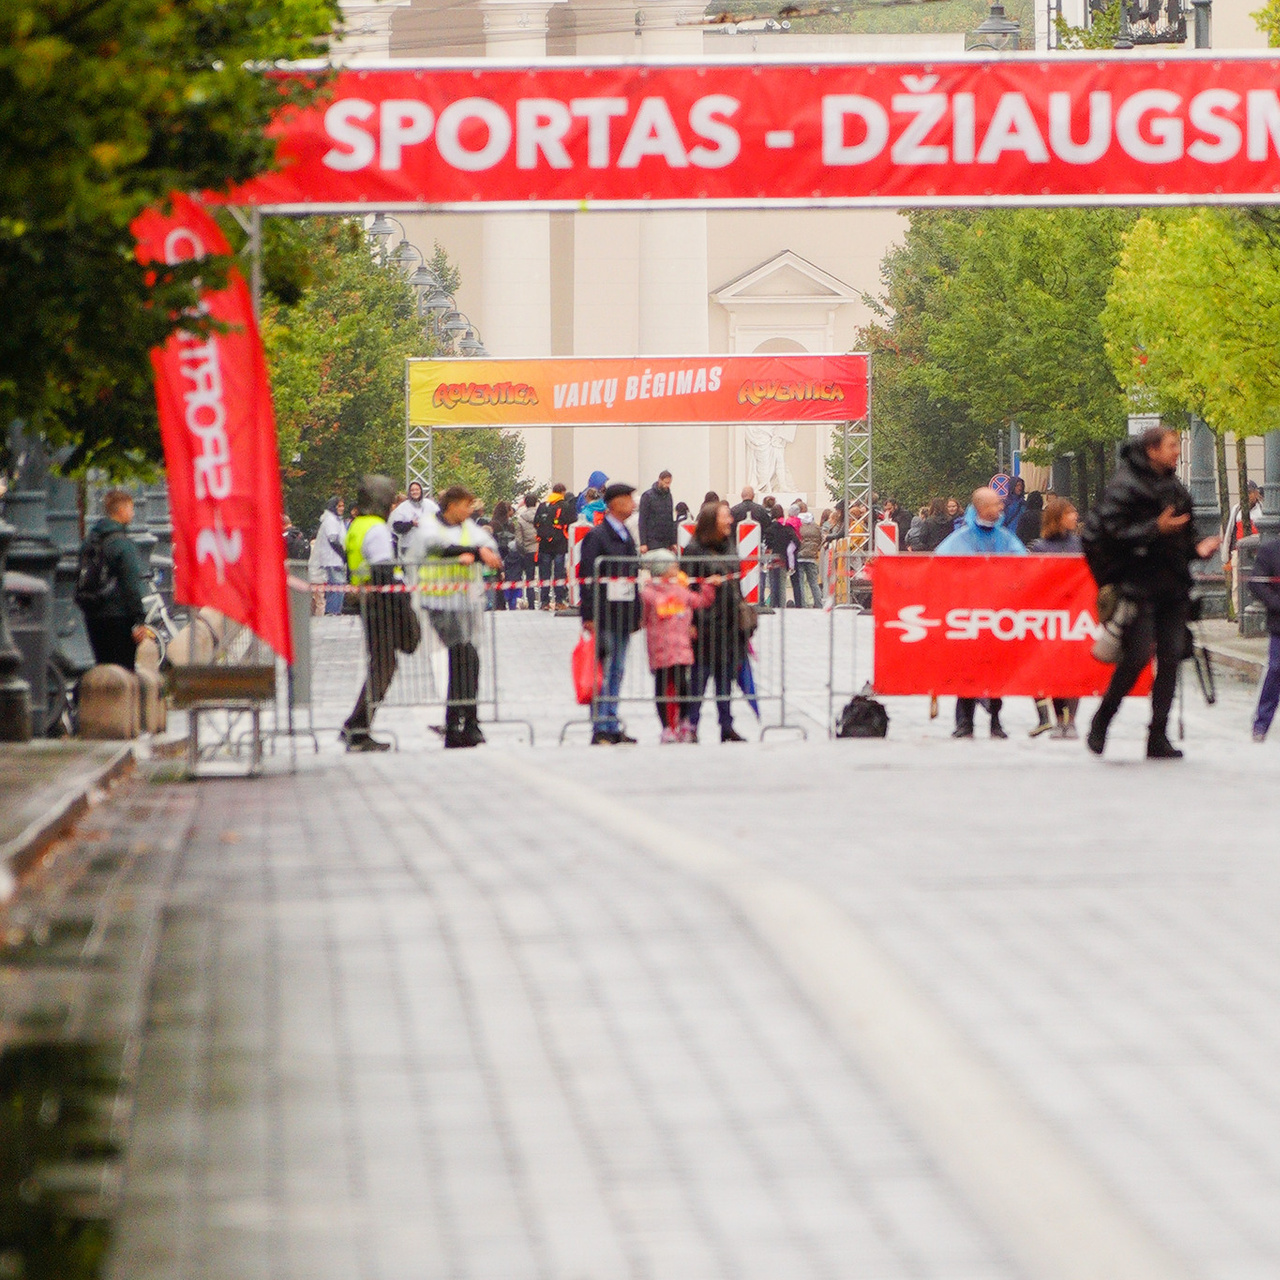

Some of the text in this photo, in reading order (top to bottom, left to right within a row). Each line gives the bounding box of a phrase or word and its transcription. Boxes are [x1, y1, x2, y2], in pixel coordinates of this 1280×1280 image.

[324, 92, 740, 172] SPORTAS
[432, 381, 539, 410] ADVENTICA
[553, 366, 723, 409] VAIKŲ BĖGIMAS
[738, 379, 845, 406] ADVENTICA
[945, 609, 1098, 641] SPORTLA
